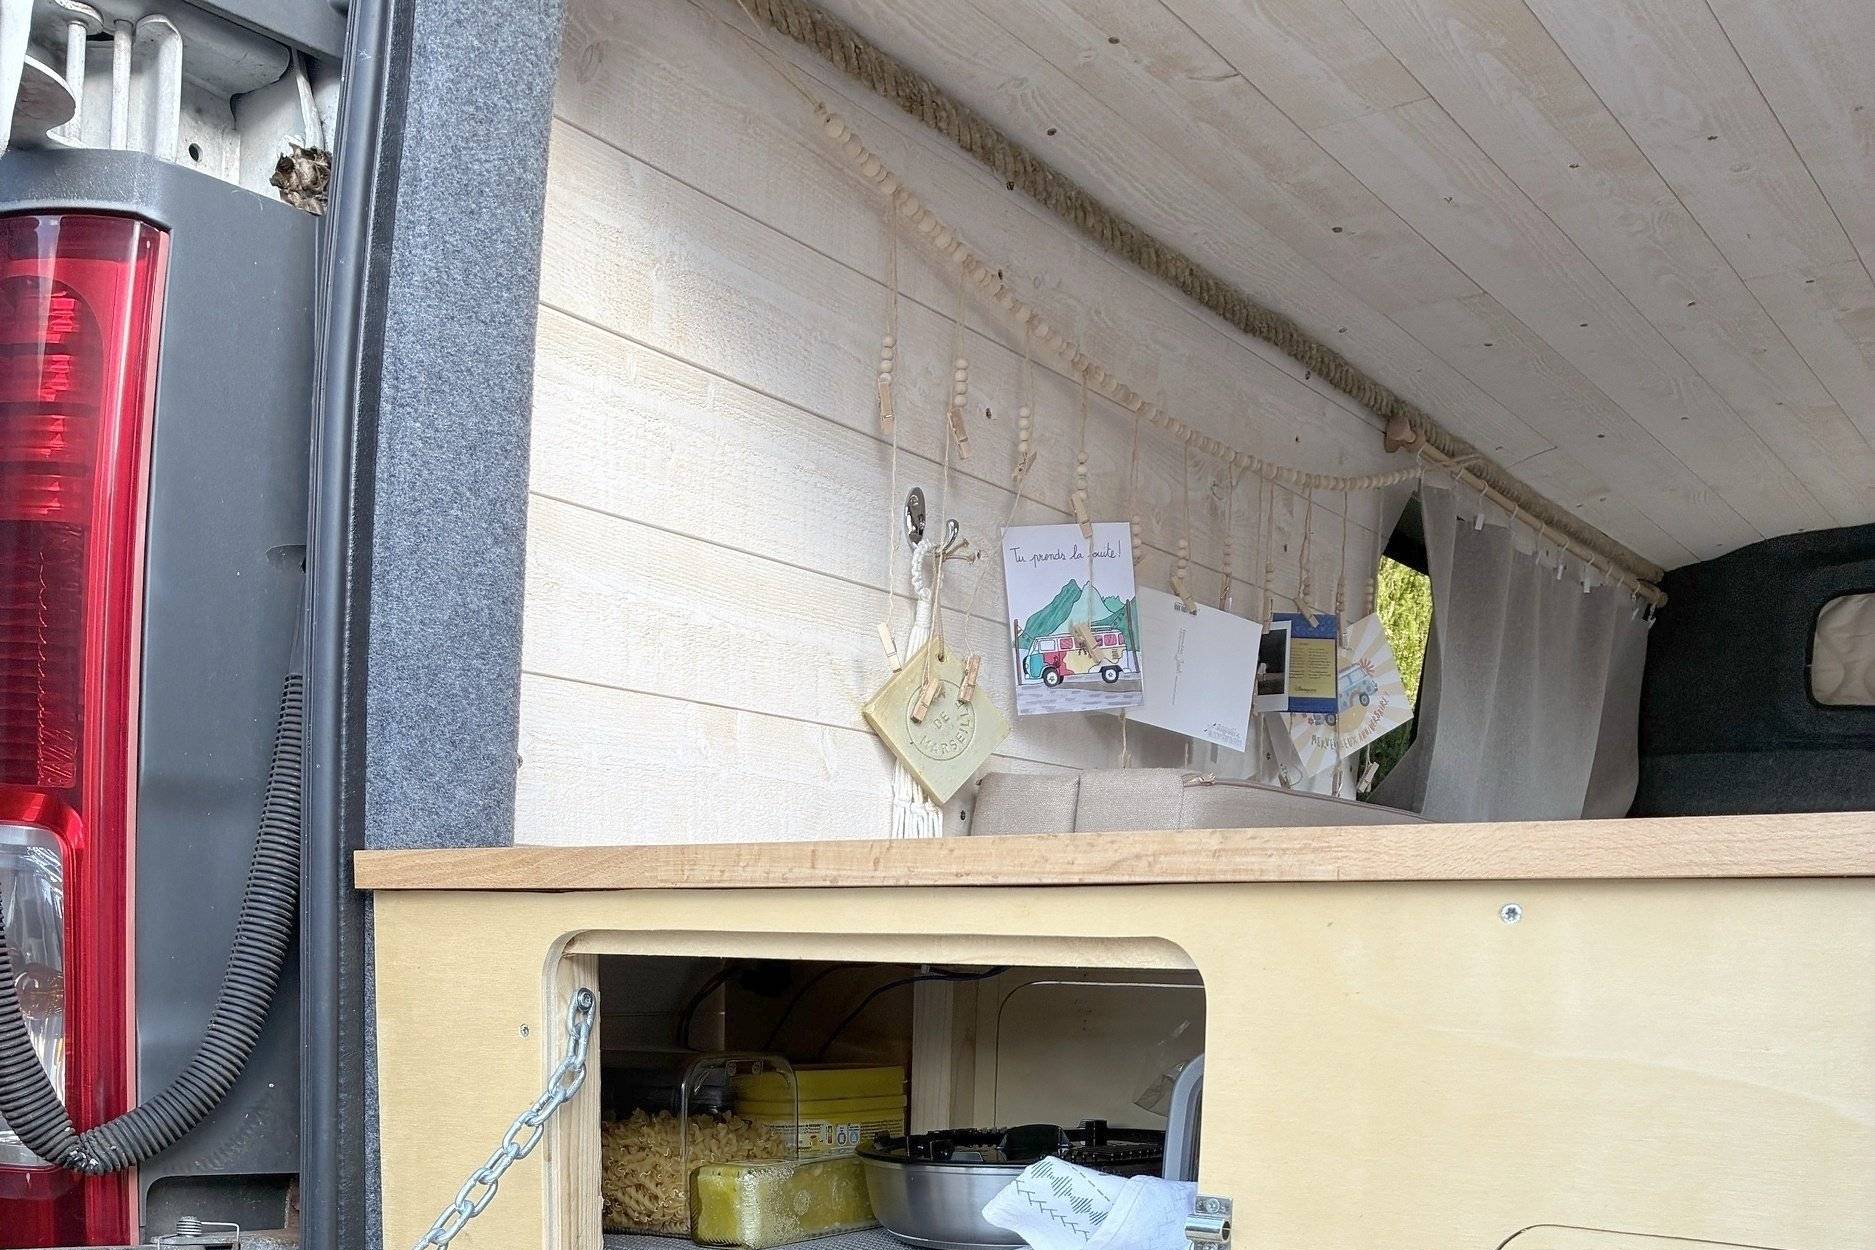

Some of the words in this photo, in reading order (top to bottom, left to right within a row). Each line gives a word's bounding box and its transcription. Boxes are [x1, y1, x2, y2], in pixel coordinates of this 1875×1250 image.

[1009, 546, 1025, 563] Tu
[1029, 548, 1067, 568] prends
[1069, 544, 1084, 560] la
[1088, 540, 1121, 559] oute!
